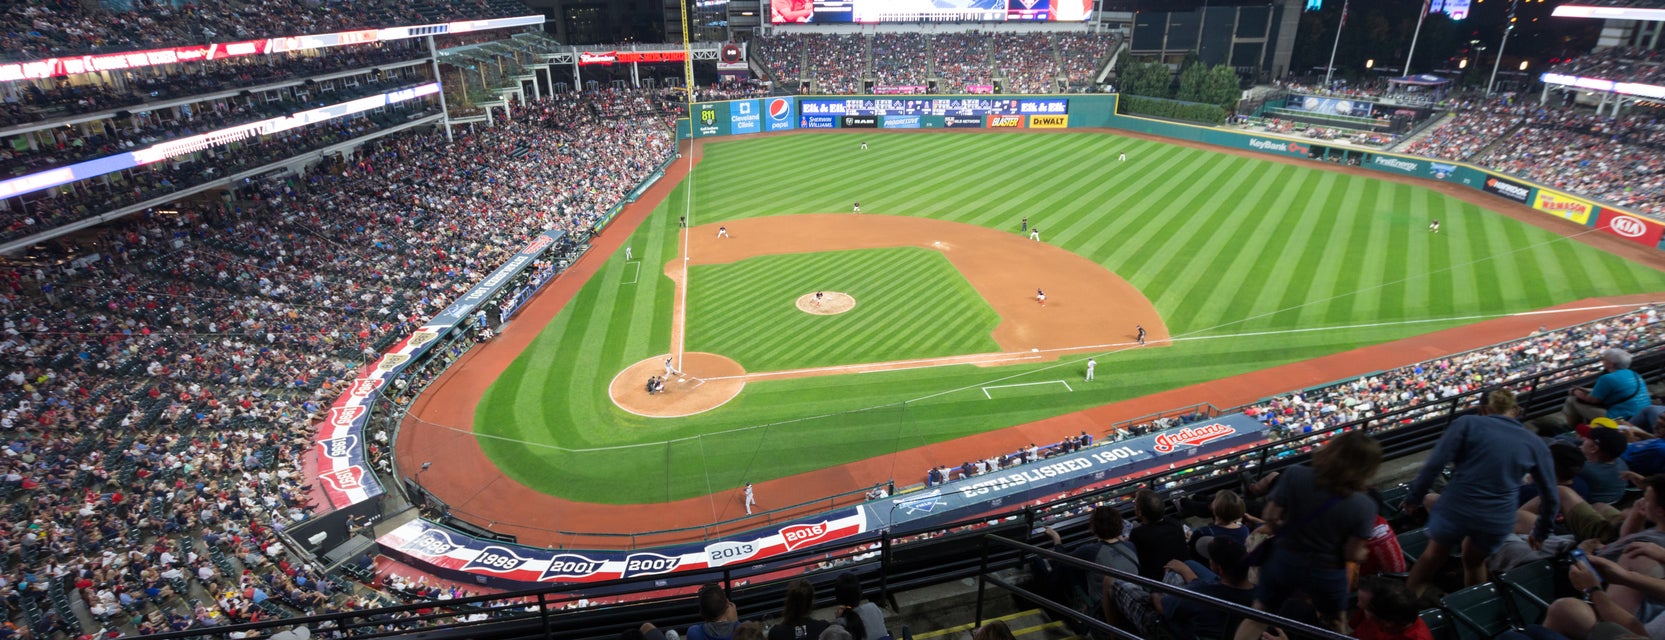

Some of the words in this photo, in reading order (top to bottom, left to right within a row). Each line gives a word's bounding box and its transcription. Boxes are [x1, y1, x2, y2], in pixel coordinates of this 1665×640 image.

[803, 103, 819, 113] Elk
[819, 103, 829, 113] &
[829, 103, 846, 113] Elk
[1020, 102, 1038, 112] Elk
[1038, 102, 1047, 112] &
[1047, 102, 1066, 112] Elk
[702, 109, 715, 121] 811
[731, 113, 760, 122] Cleveland
[738, 120, 755, 129] Clinic
[771, 121, 789, 129] pepsi
[1249, 138, 1287, 152] KeyBank
[1154, 422, 1236, 453] Indians
[959, 457, 1093, 498] ESTABLISHED
[1092, 446, 1143, 465] 1901.
[785, 525, 824, 541] 2016
[415, 536, 450, 556] 1998
[711, 544, 754, 560] 2013
[475, 552, 520, 569] 1999
[628, 558, 677, 571] 2007
[550, 561, 595, 574] 2001
